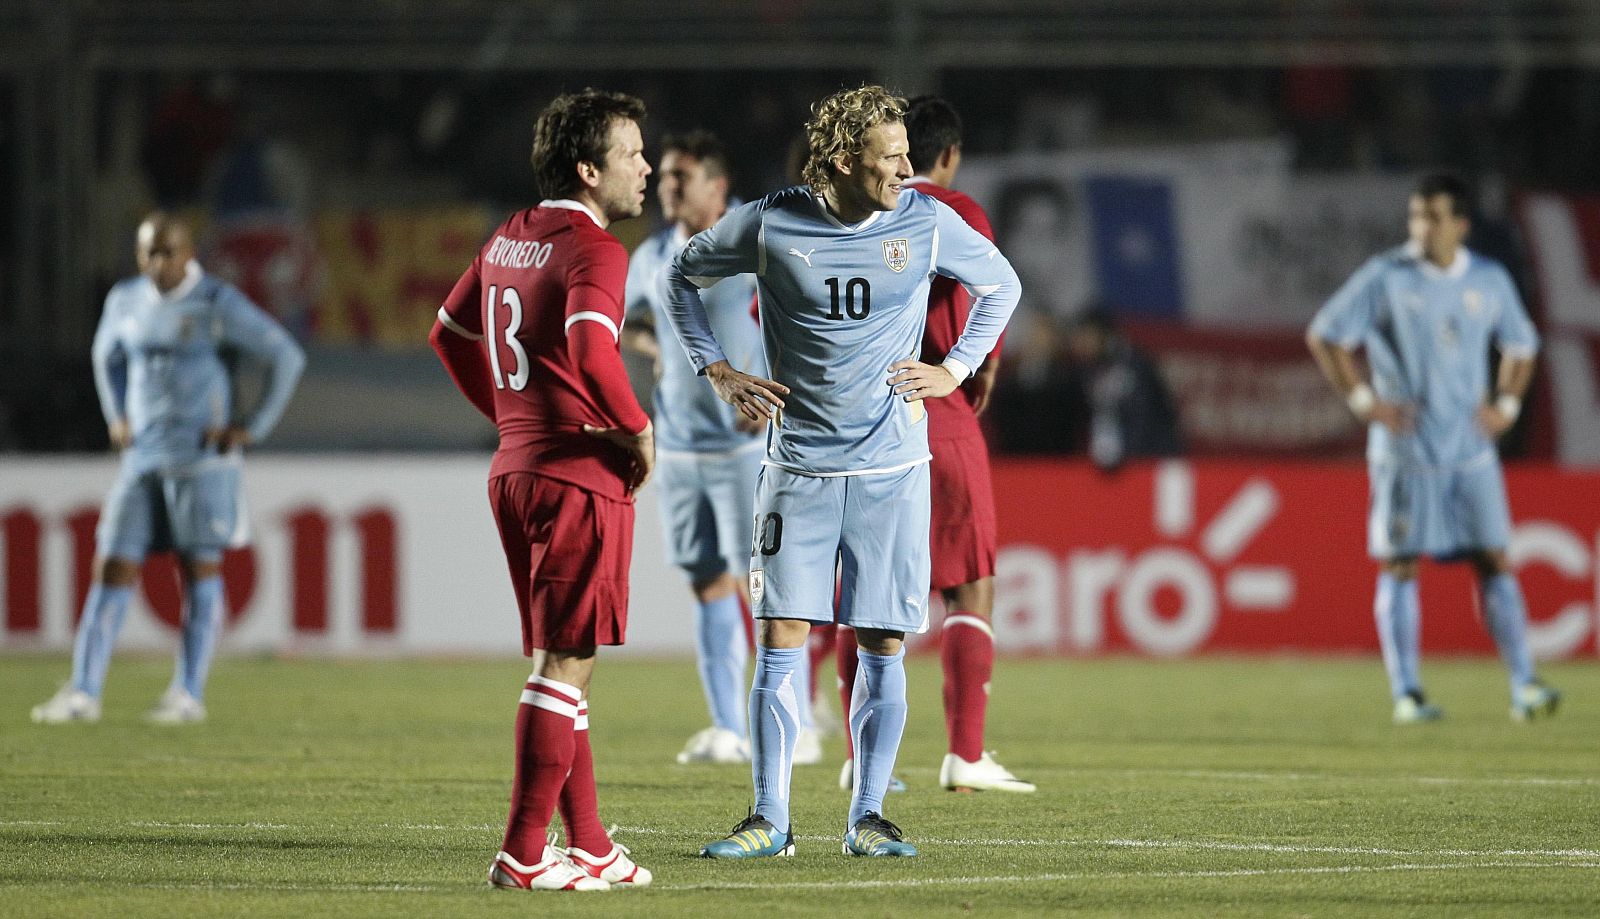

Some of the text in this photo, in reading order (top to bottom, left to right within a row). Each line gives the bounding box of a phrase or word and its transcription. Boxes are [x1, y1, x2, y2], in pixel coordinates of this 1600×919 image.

[488, 285, 529, 392] 13
[825, 277, 870, 320] 10
[988, 545, 1219, 655] aro
